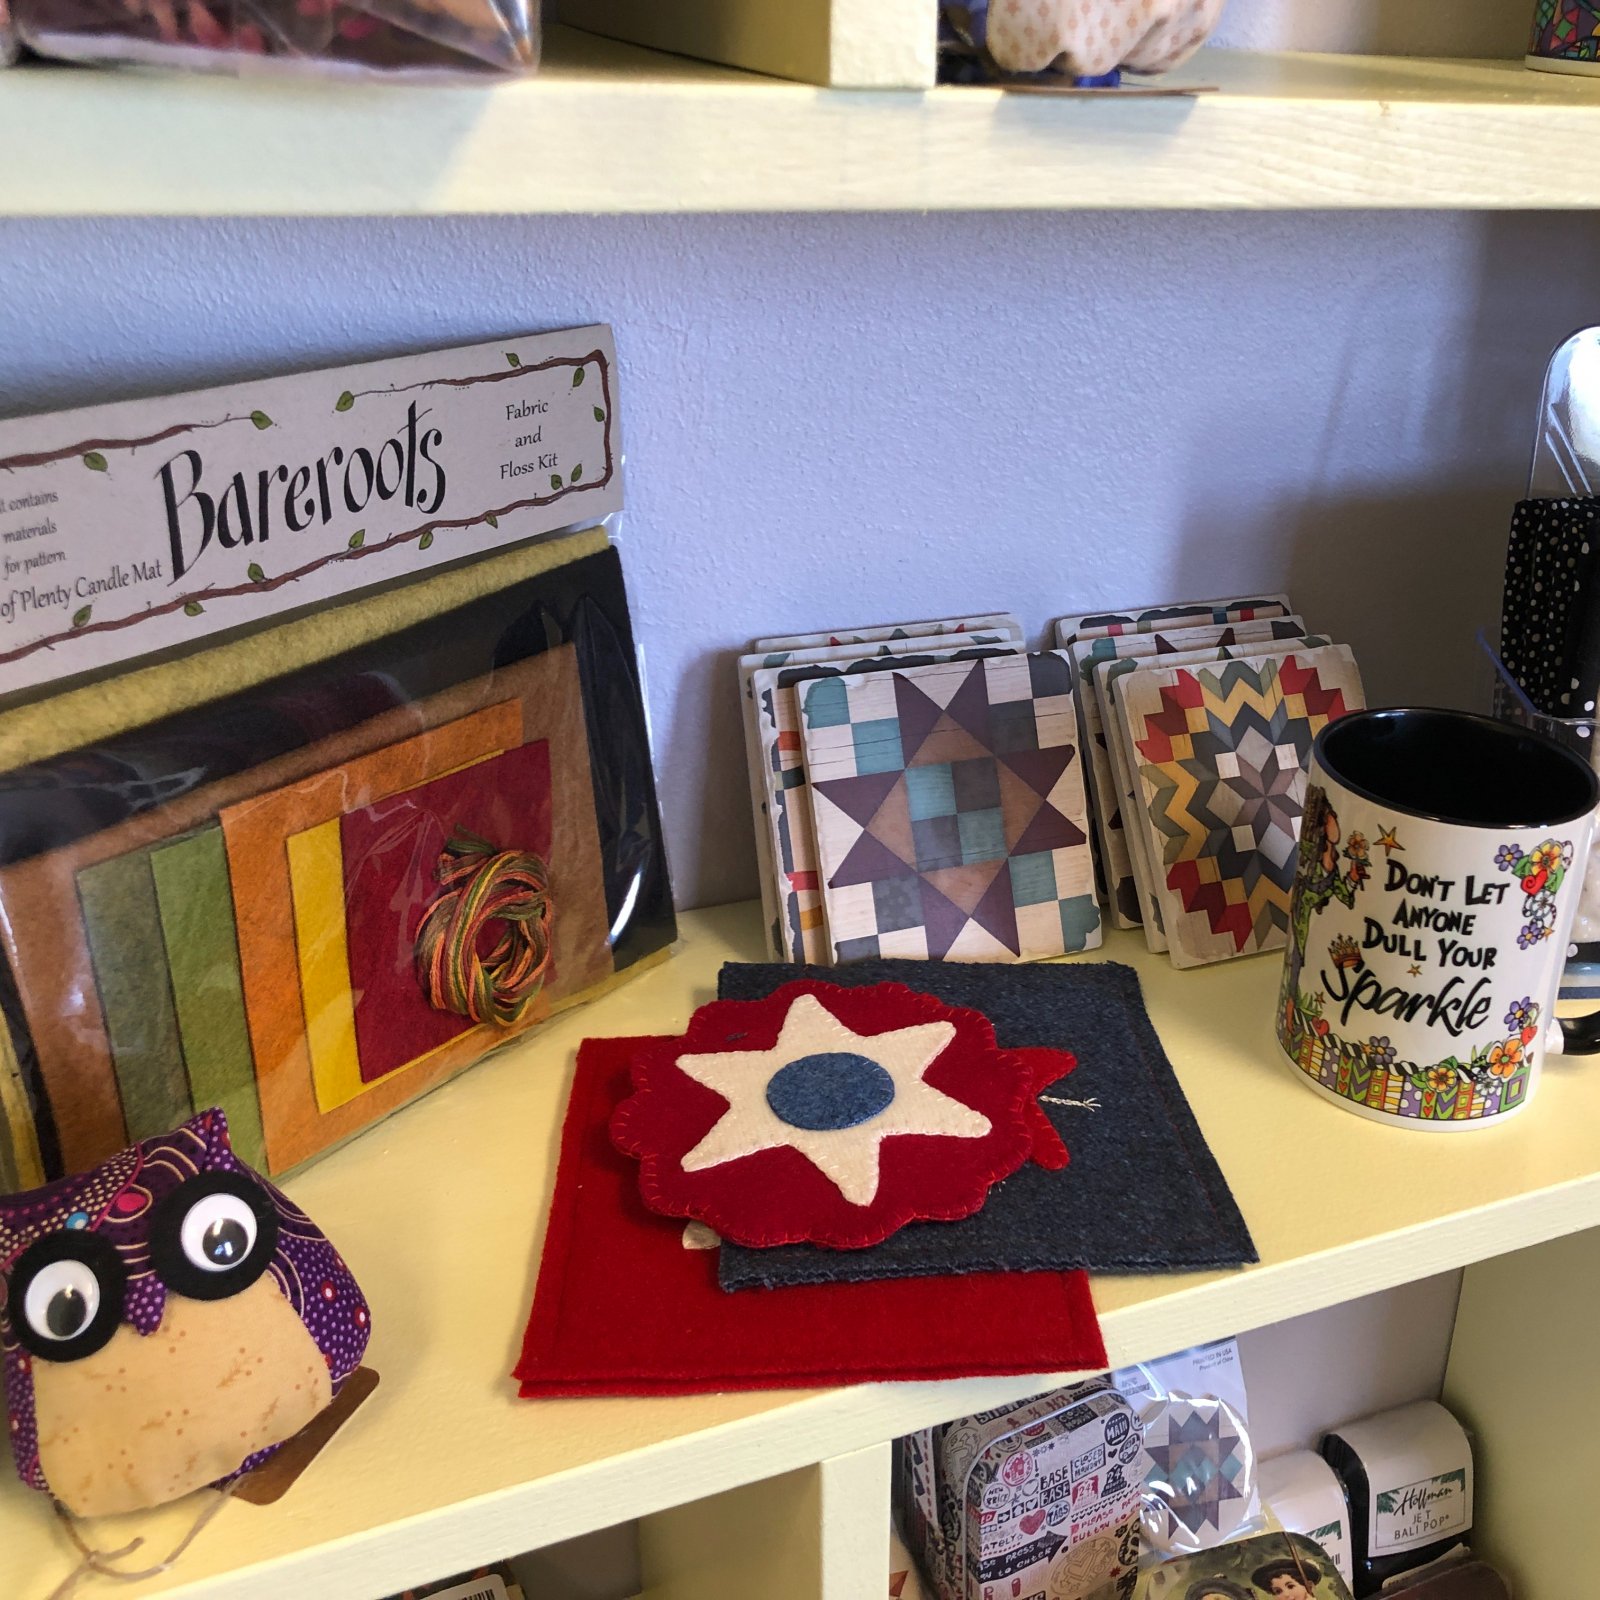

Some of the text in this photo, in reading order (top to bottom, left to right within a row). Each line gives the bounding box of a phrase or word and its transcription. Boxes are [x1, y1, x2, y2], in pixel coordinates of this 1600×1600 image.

[505, 399, 549, 420] Fabric
[515, 425, 542, 447] and
[500, 453, 558, 480] Floss Kit
[9, 491, 59, 511] contains
[160, 400, 447, 588] Bareroots
[3, 517, 57, 543] materials
[3, 551, 66, 580] for pattern
[0, 559, 163, 624] of Plenty Candle Mat
[1384, 858, 1510, 905] DON'T LET
[1392, 898, 1476, 935] ANYONE
[1362, 916, 1497, 970] DULL YOUR
[1320, 960, 1492, 1037] Sparkle
[1107, 1419, 1128, 1441] MAIN
[1074, 1449, 1103, 1468] CLOSED
[1040, 1465, 1068, 1491] BASE
[1107, 1468, 1122, 1483] 24
[1040, 1481, 1070, 1506] BASE
[1394, 1487, 1453, 1516] Hoffman
[1394, 1527, 1419, 1541] BALI
